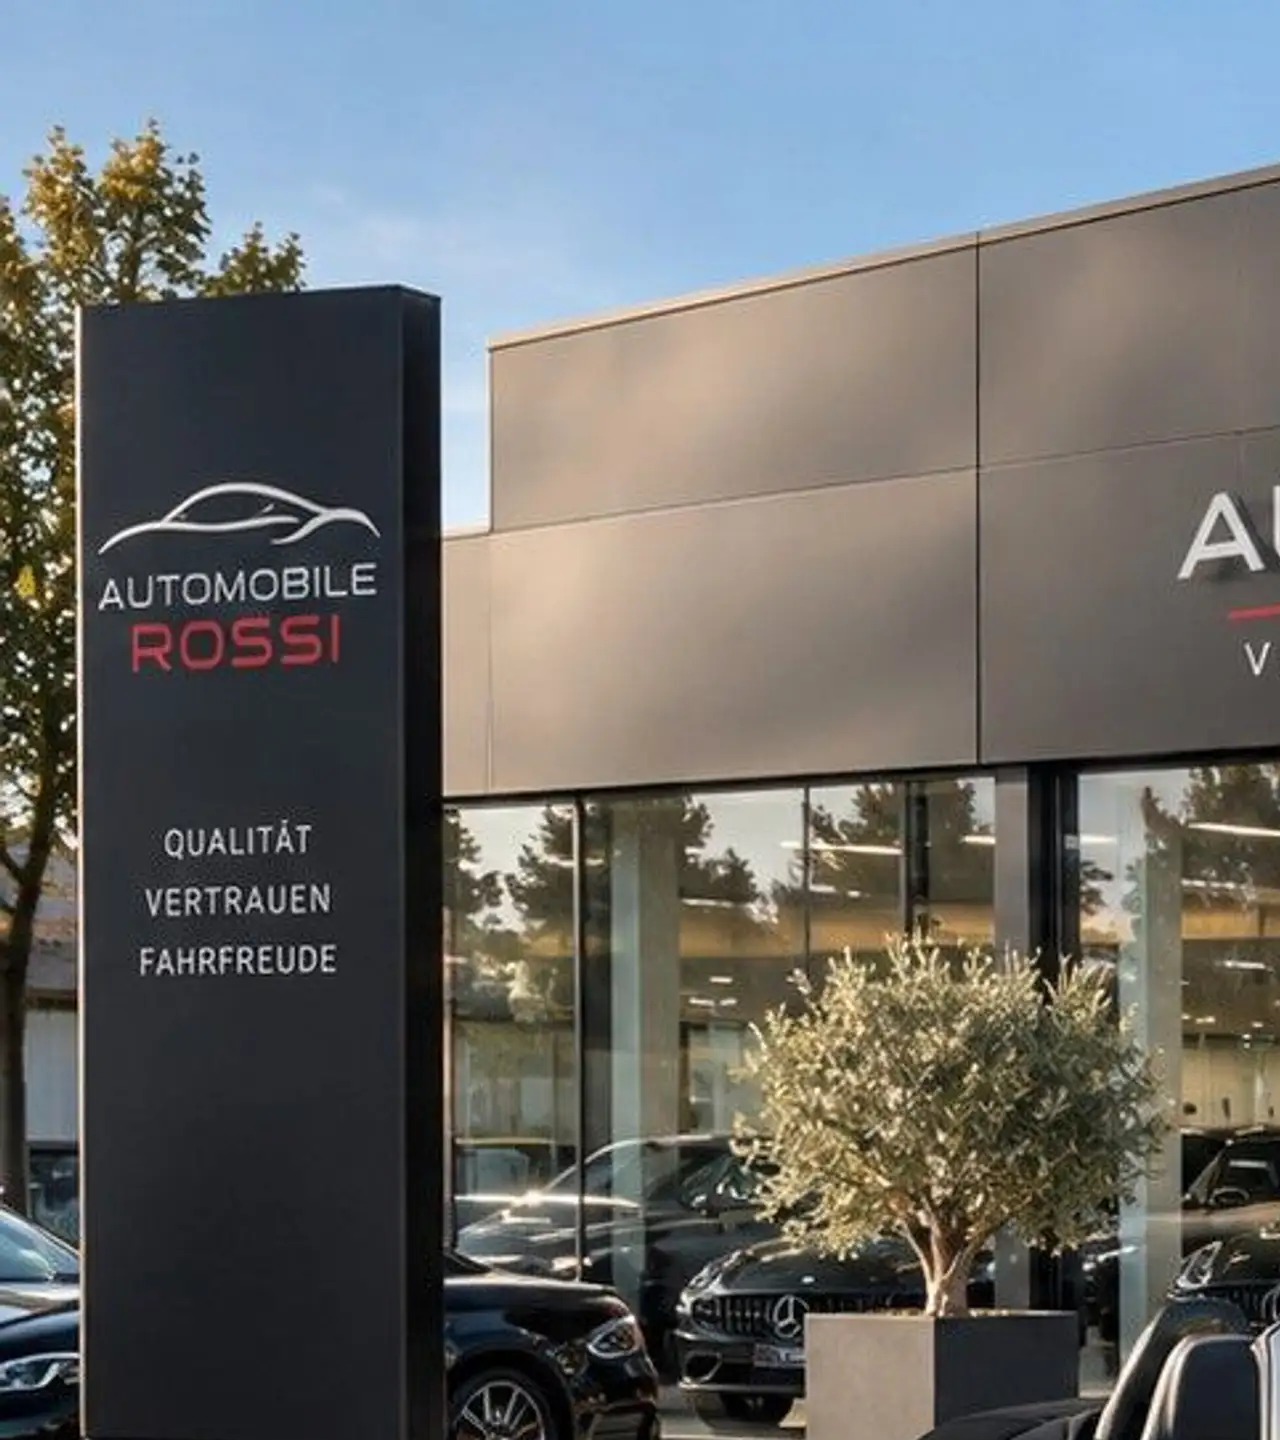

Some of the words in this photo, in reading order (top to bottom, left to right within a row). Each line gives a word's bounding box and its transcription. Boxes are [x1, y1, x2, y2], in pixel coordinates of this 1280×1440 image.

[99, 564, 376, 610] AUTOMOBILE
[130, 614, 341, 671] ROSSI
[146, 885, 329, 916] VERTRAUEN
[141, 945, 335, 975] FAHRFREUDE
